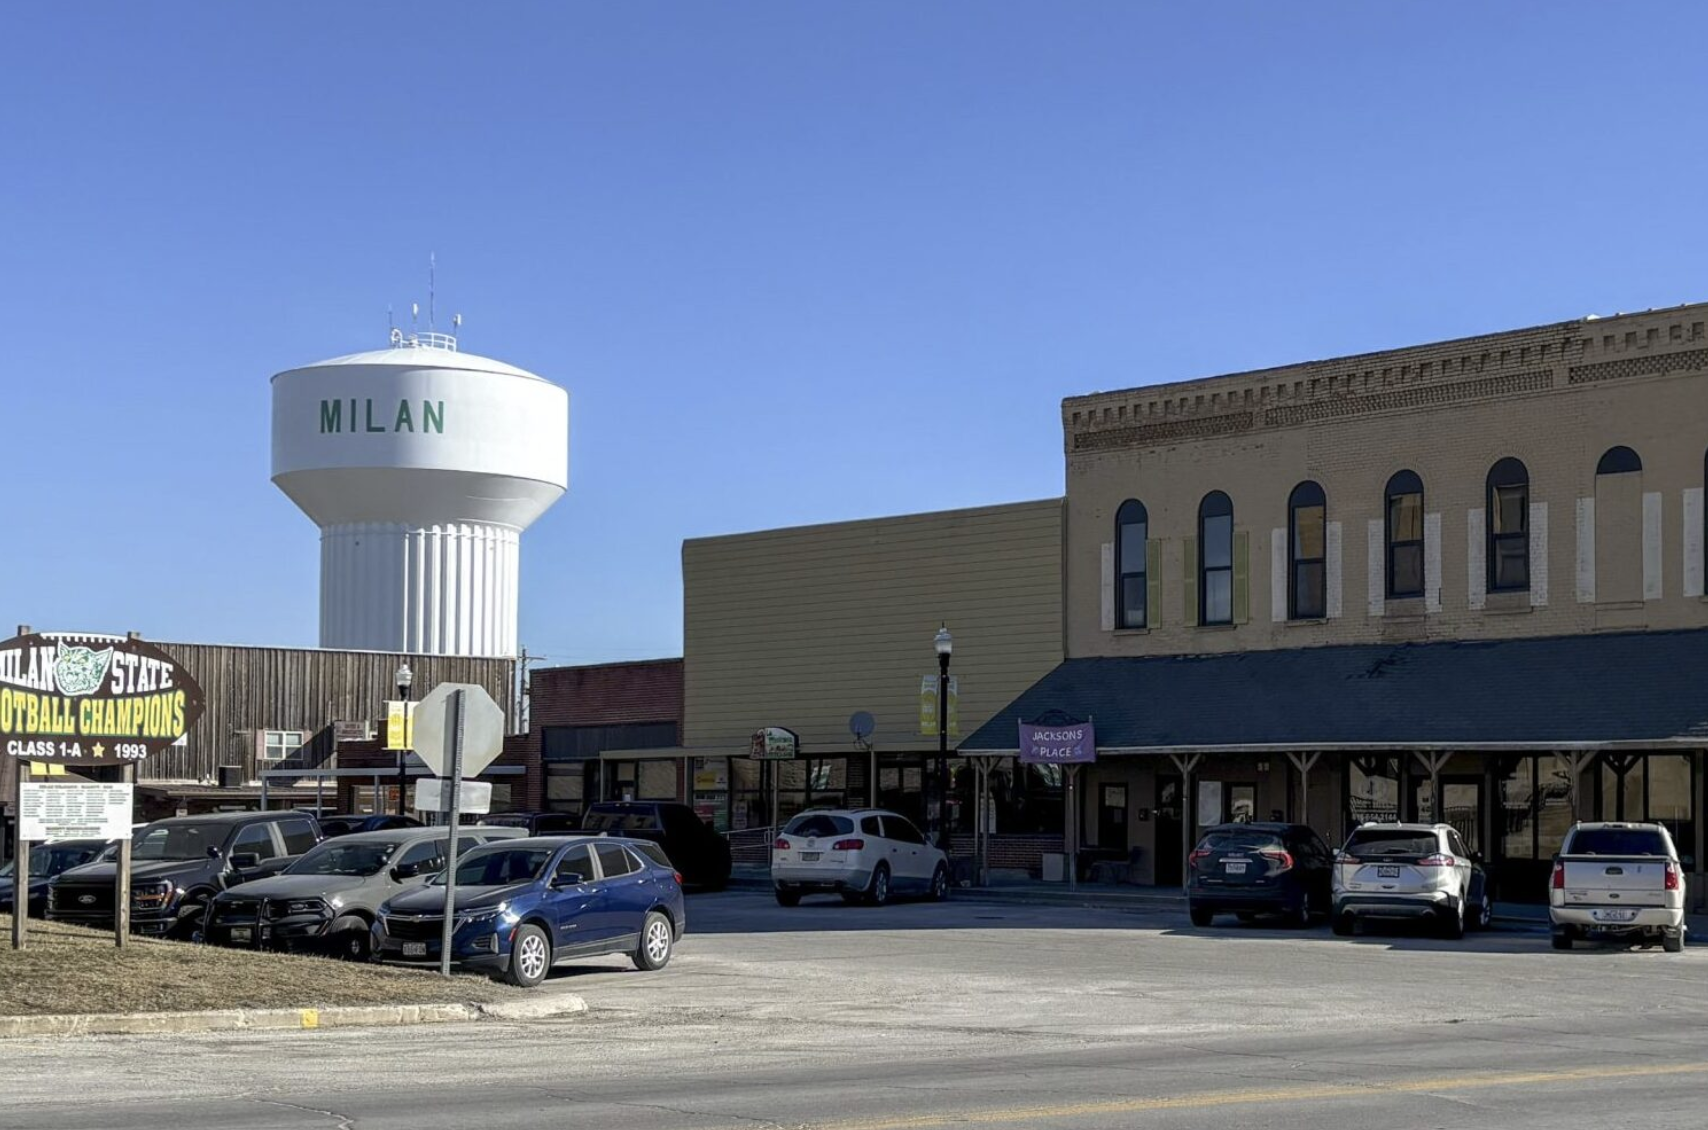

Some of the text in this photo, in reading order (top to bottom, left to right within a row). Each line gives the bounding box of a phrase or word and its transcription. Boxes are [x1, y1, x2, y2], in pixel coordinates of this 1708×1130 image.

[320, 399, 444, 433] MILAN
[111, 651, 174, 695] STATE
[80, 689, 186, 738] CHAMPIONS
[1032, 729, 1083, 742] JACKSONS
[7, 740, 147, 759] CLASS 1-A 1993
[1040, 746, 1072, 757] PLACE
